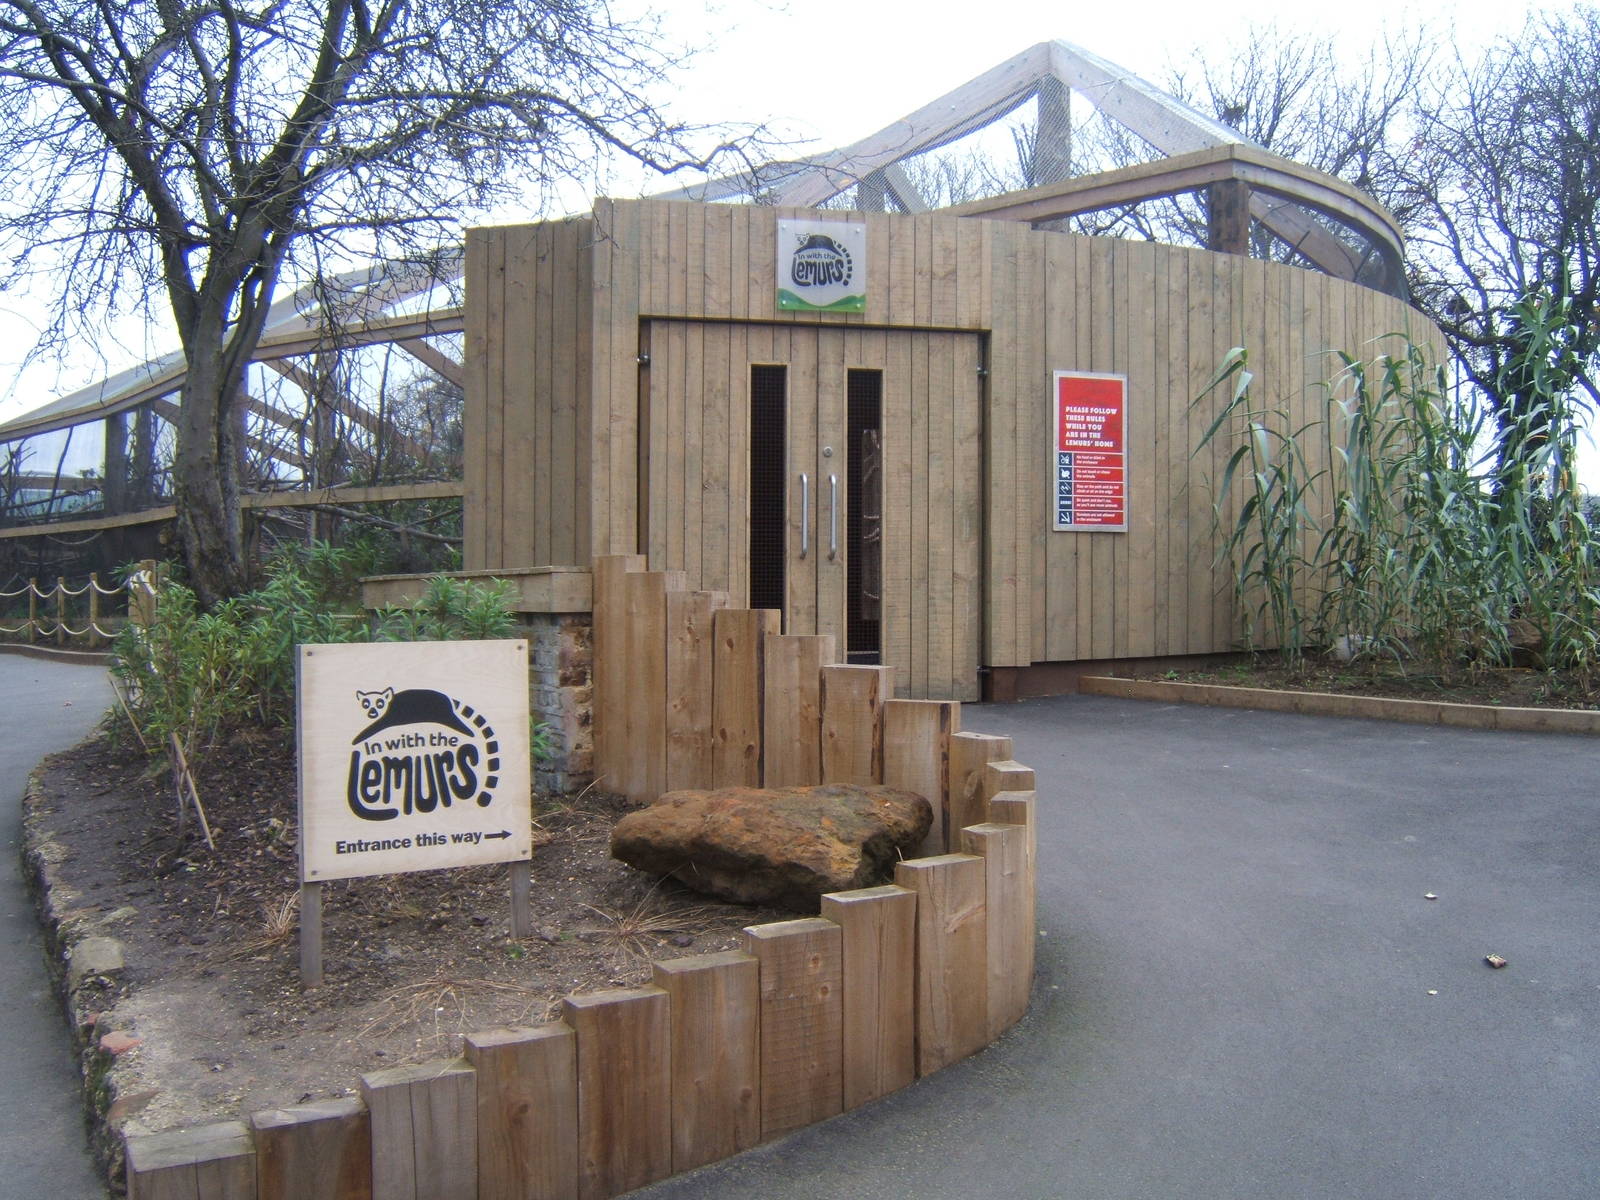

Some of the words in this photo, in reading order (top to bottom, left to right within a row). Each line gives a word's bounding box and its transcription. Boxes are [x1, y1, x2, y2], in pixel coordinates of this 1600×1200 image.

[824, 252, 836, 260] the
[791, 258, 844, 287] Lemurs
[1065, 406, 1089, 414] PLEASE
[1089, 407, 1118, 415] FOLLOW
[1065, 414, 1086, 422] THESE
[1086, 415, 1106, 423] RULES
[1094, 440, 1114, 448] HOME
[364, 741, 383, 756] In
[385, 733, 426, 750] with
[429, 732, 459, 748] the
[347, 743, 479, 822] Lemurs
[335, 836, 412, 855] Entrance
[415, 832, 448, 848] this
[451, 831, 483, 846] way
